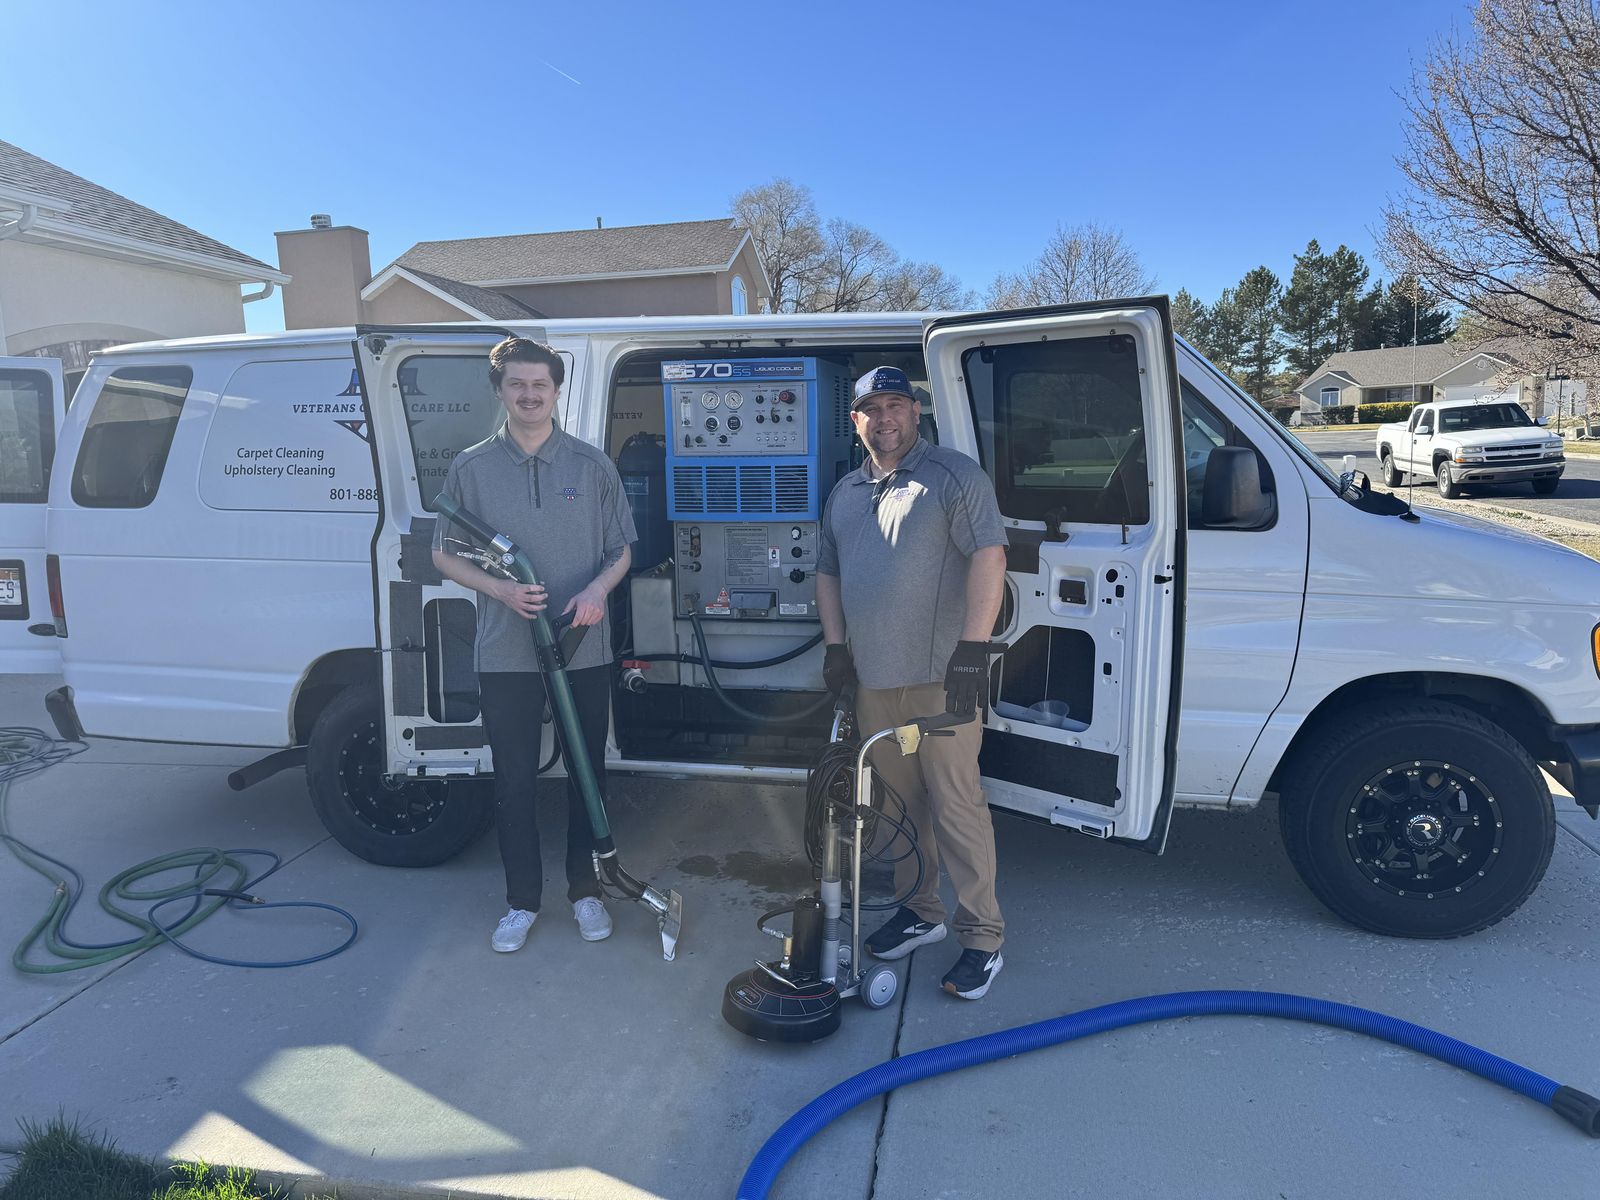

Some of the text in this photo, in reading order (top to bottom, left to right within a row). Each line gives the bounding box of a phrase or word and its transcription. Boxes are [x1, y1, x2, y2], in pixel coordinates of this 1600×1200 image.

[292, 403, 356, 414] VETERANS
[411, 403, 444, 413] CARE
[447, 403, 471, 413] LLC
[236, 447, 324, 461] Carpet Cleaning
[429, 448, 439, 459] &
[224, 464, 336, 478] Upholstery Cleaning
